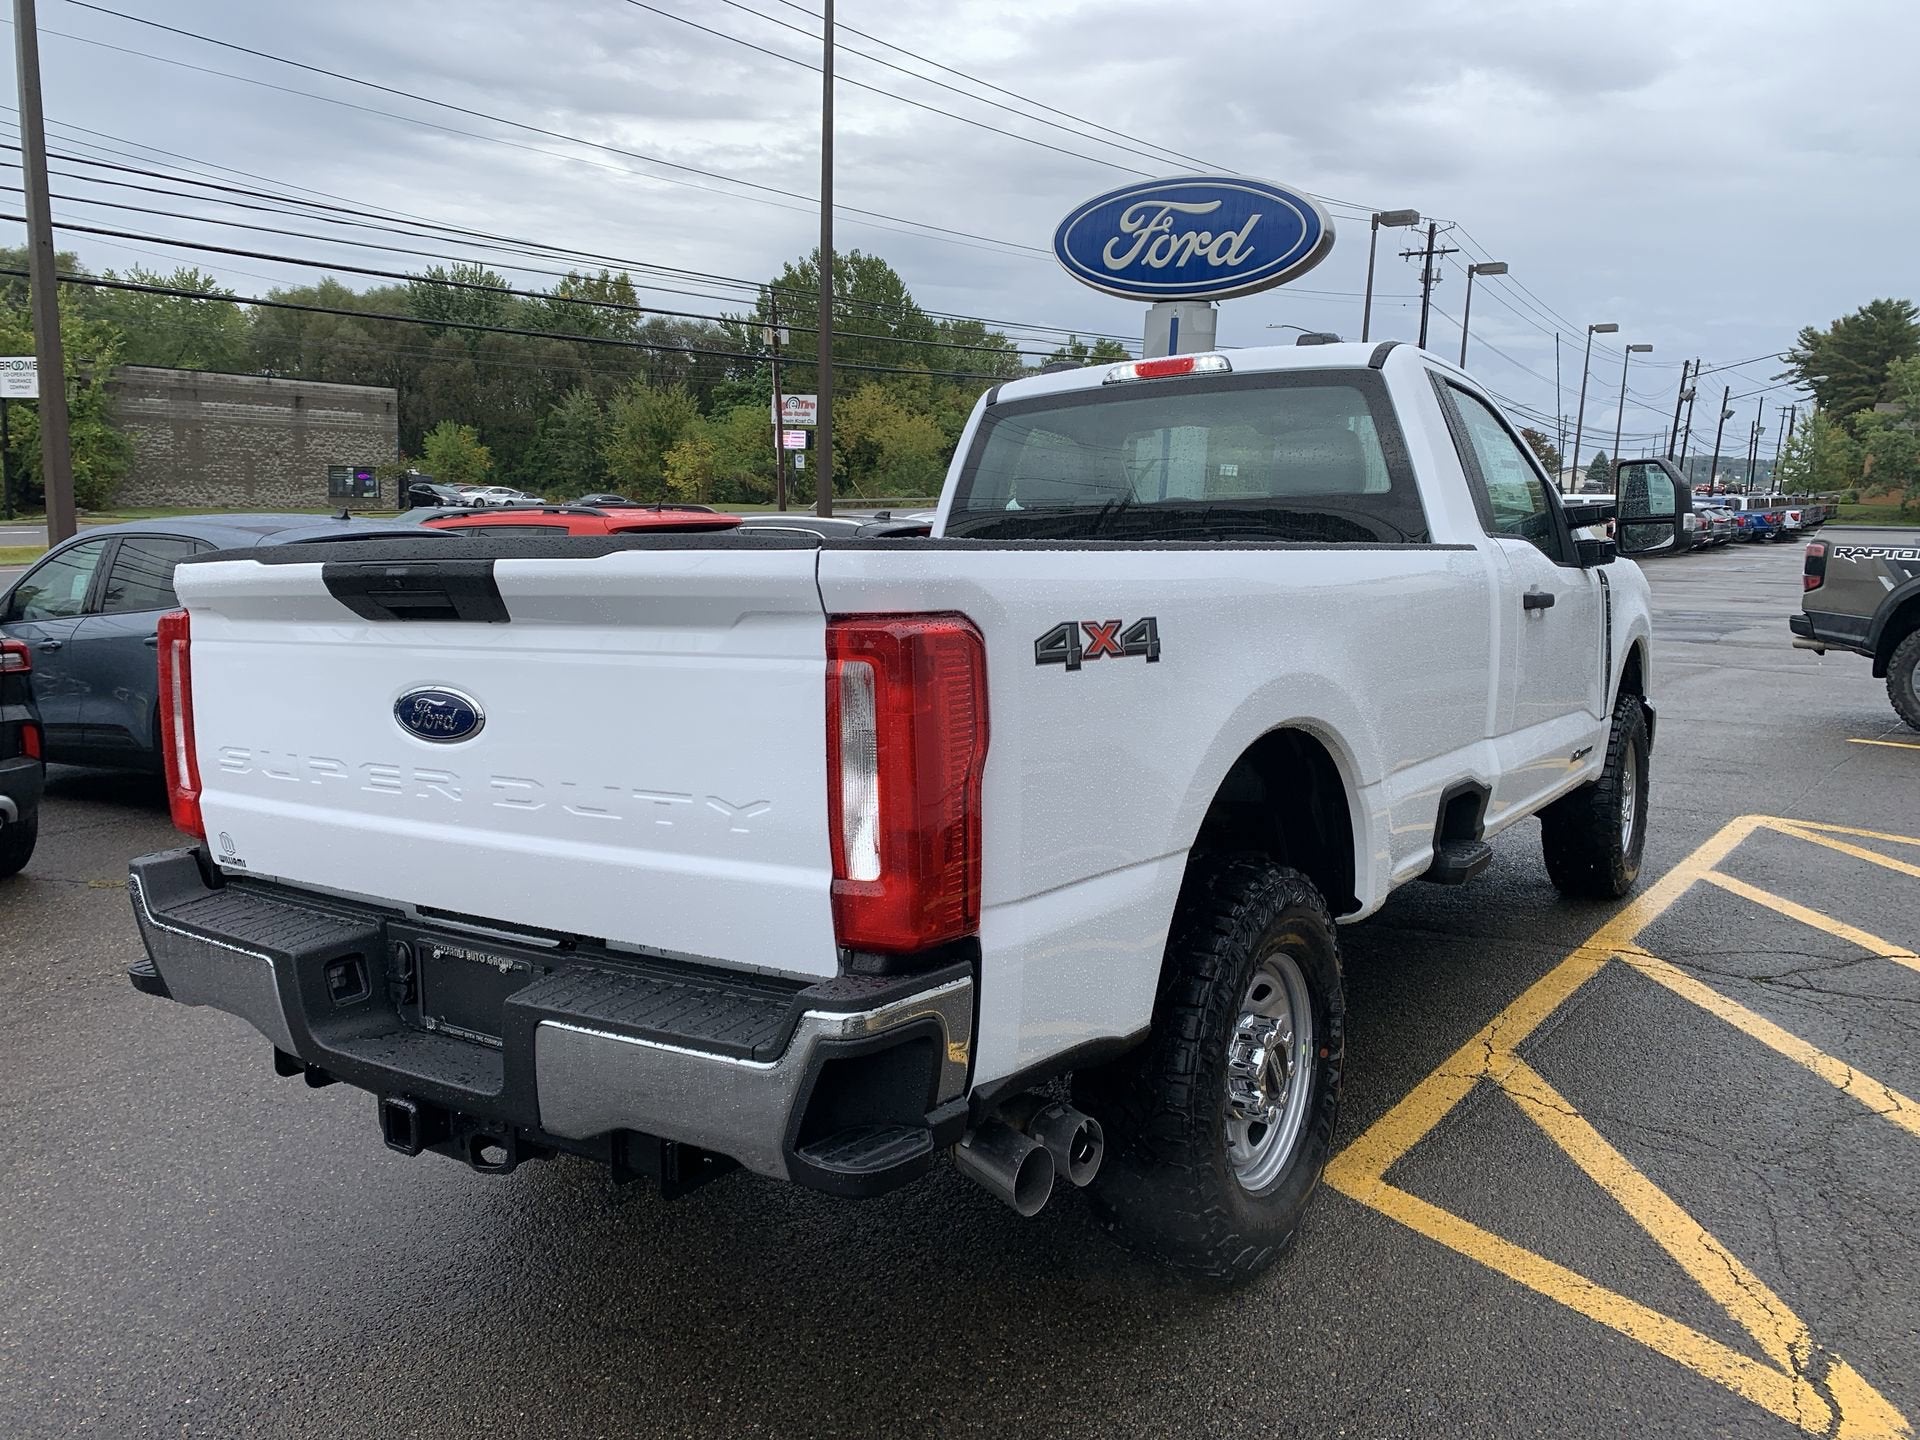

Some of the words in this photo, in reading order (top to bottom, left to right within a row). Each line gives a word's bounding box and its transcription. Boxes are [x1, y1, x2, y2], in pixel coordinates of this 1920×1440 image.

[1103, 200, 1262, 271] Ford
[1834, 546, 1920, 563] RAPTO
[411, 697, 459, 731] Ford
[218, 746, 463, 801] SUPER
[490, 775, 771, 832] DUTY
[218, 855, 247, 867] WILLIAMS
